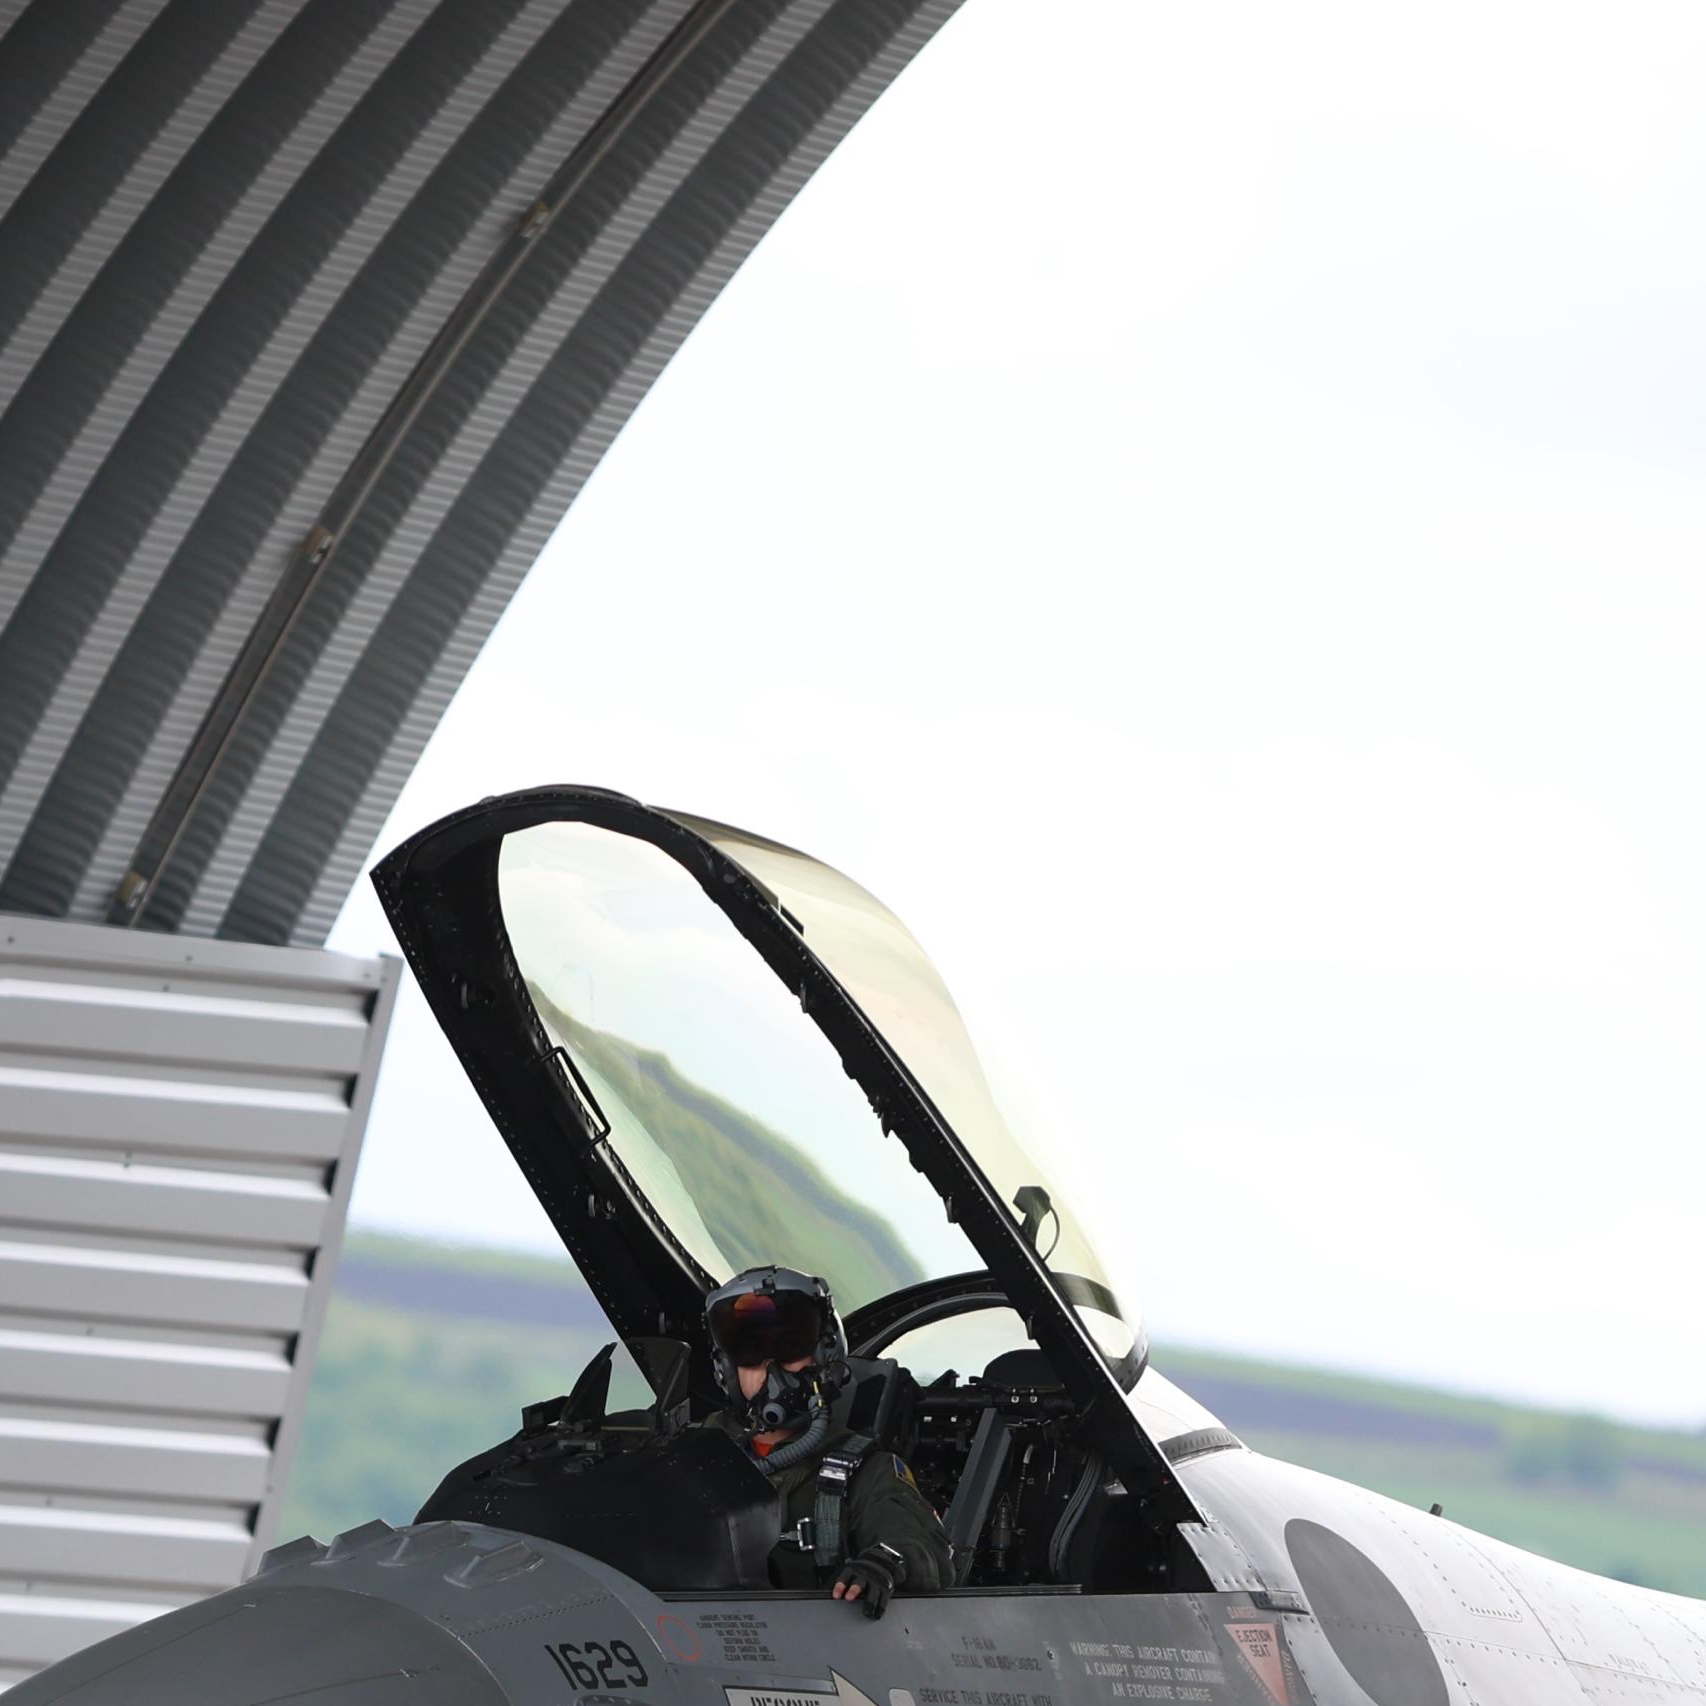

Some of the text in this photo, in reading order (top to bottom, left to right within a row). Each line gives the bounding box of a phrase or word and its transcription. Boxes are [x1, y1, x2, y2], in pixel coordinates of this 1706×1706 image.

[1235, 1629, 1274, 1643] EJECTION
[1112, 1643, 1135, 1658] THIS
[1136, 1646, 1180, 1663] AIRCRAFT
[1250, 1644, 1272, 1657] SEAT
[544, 1640, 649, 1690] 1629
[1085, 1662, 1093, 1676] A
[1094, 1663, 1130, 1678] CANOPY
[1132, 1665, 1173, 1681] REMOVER
[919, 1688, 959, 1704] SERVICE
[960, 1690, 983, 1705] THIS
[1112, 1682, 1213, 1702] AN EXPLOSIVE CHARGE
